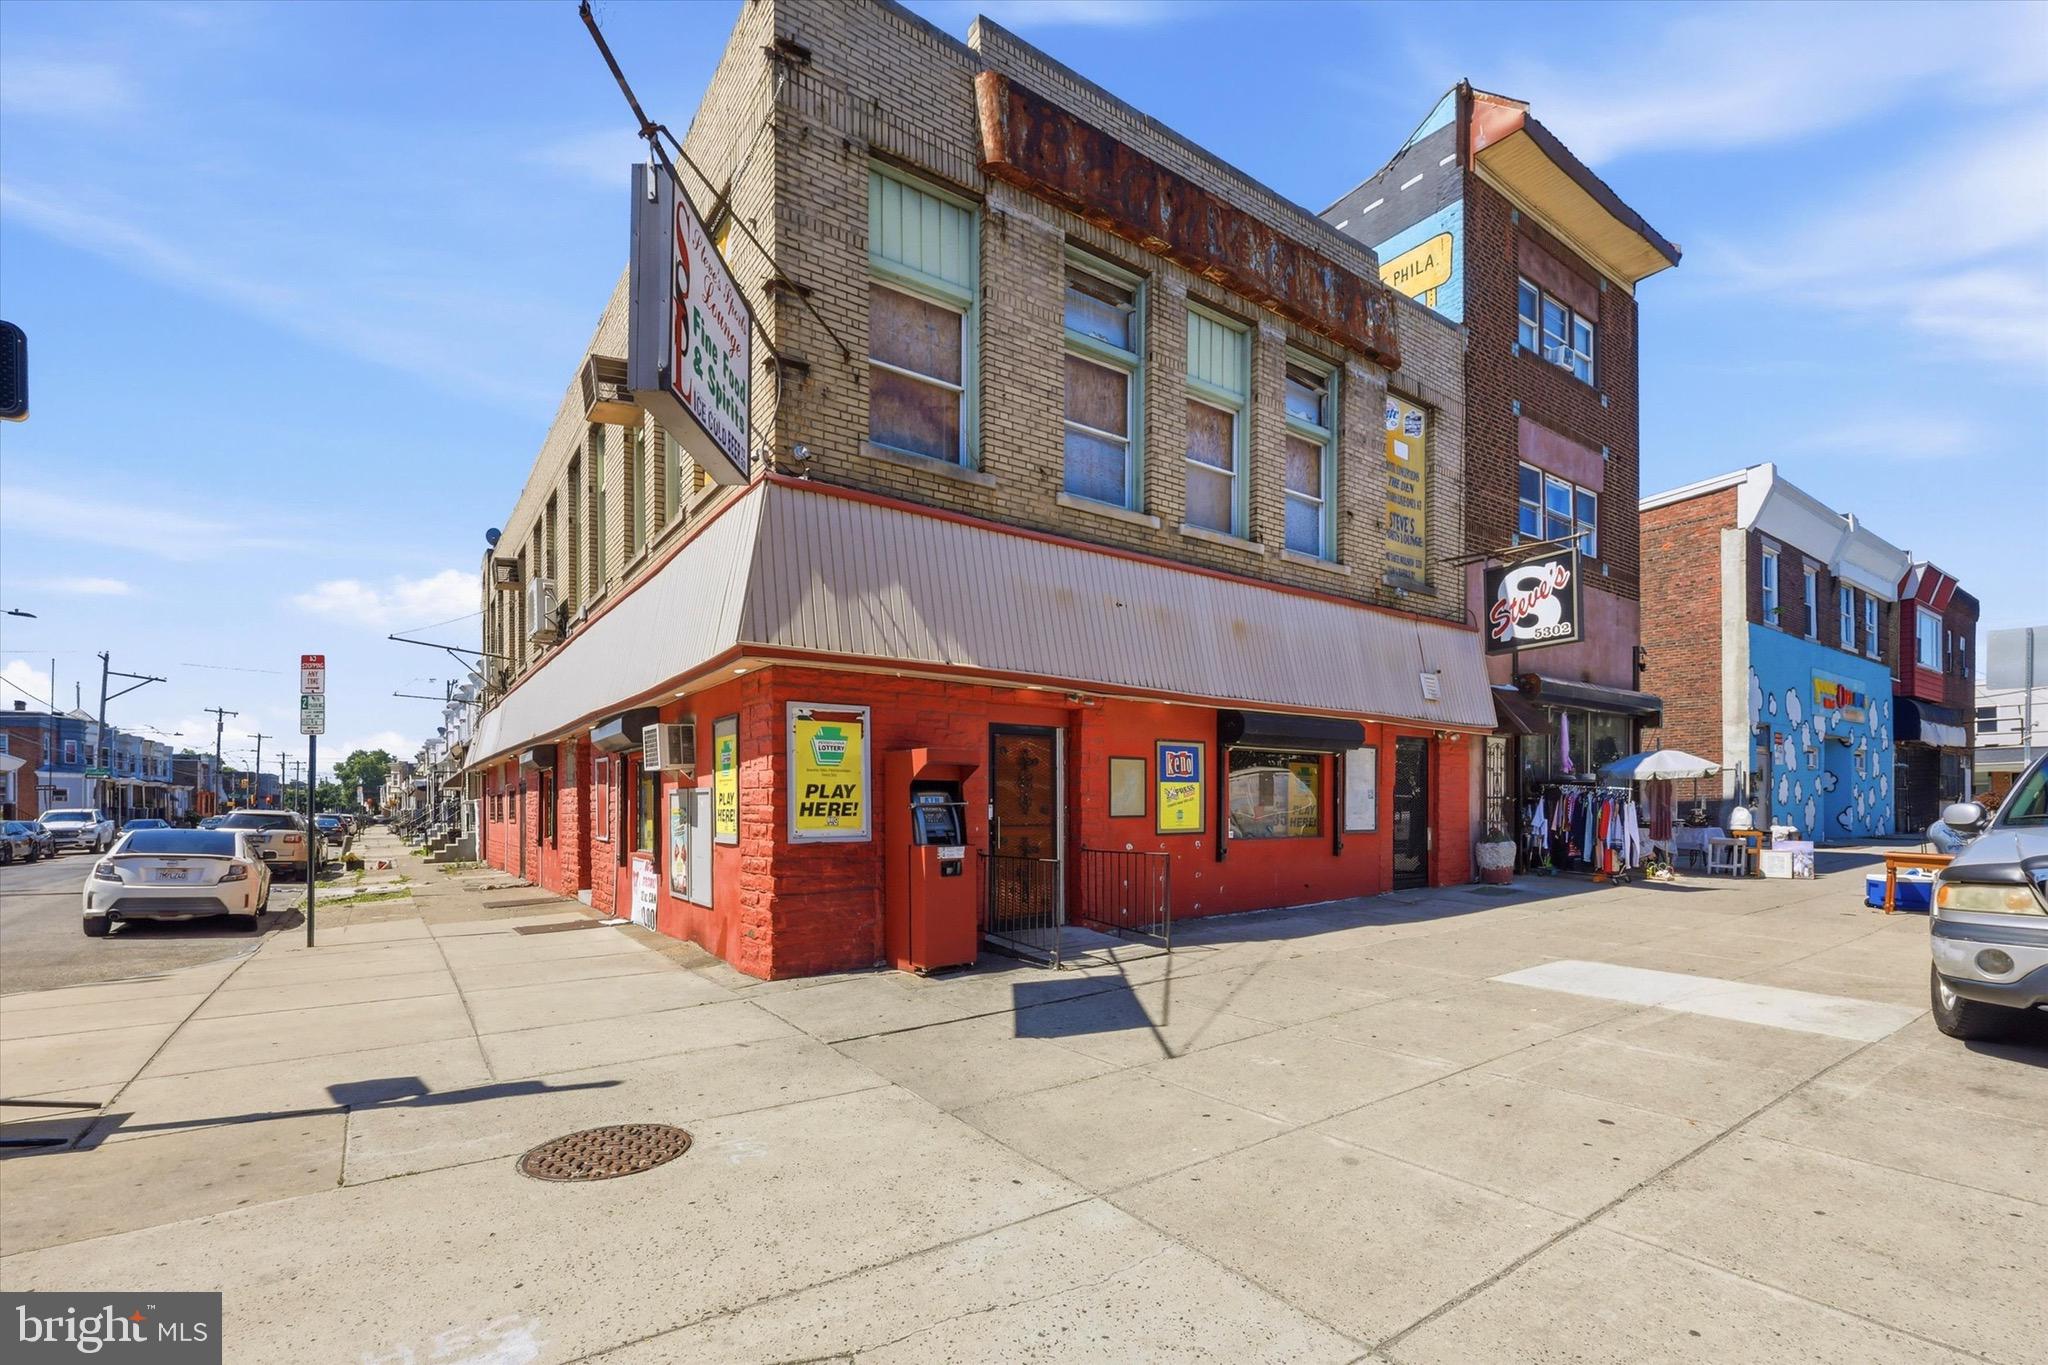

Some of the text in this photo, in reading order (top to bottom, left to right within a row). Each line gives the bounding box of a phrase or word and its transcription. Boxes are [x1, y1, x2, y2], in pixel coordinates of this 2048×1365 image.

[702, 275, 742, 358] Lounge
[693, 305, 746, 407] Fine Food
[693, 345, 745, 435] & Spirits
[693, 390, 707, 424] ICE
[708, 410, 727, 446] COLD
[727, 430, 741, 462] BEER
[1490, 565, 1570, 639] Steve's
[1534, 622, 1572, 639] 5302
[1167, 751, 1192, 775] keno
[719, 792, 735, 806] PLAY
[805, 783, 856, 799] PLAY
[717, 808, 736, 823] HERE!
[799, 801, 859, 817] HERE!
